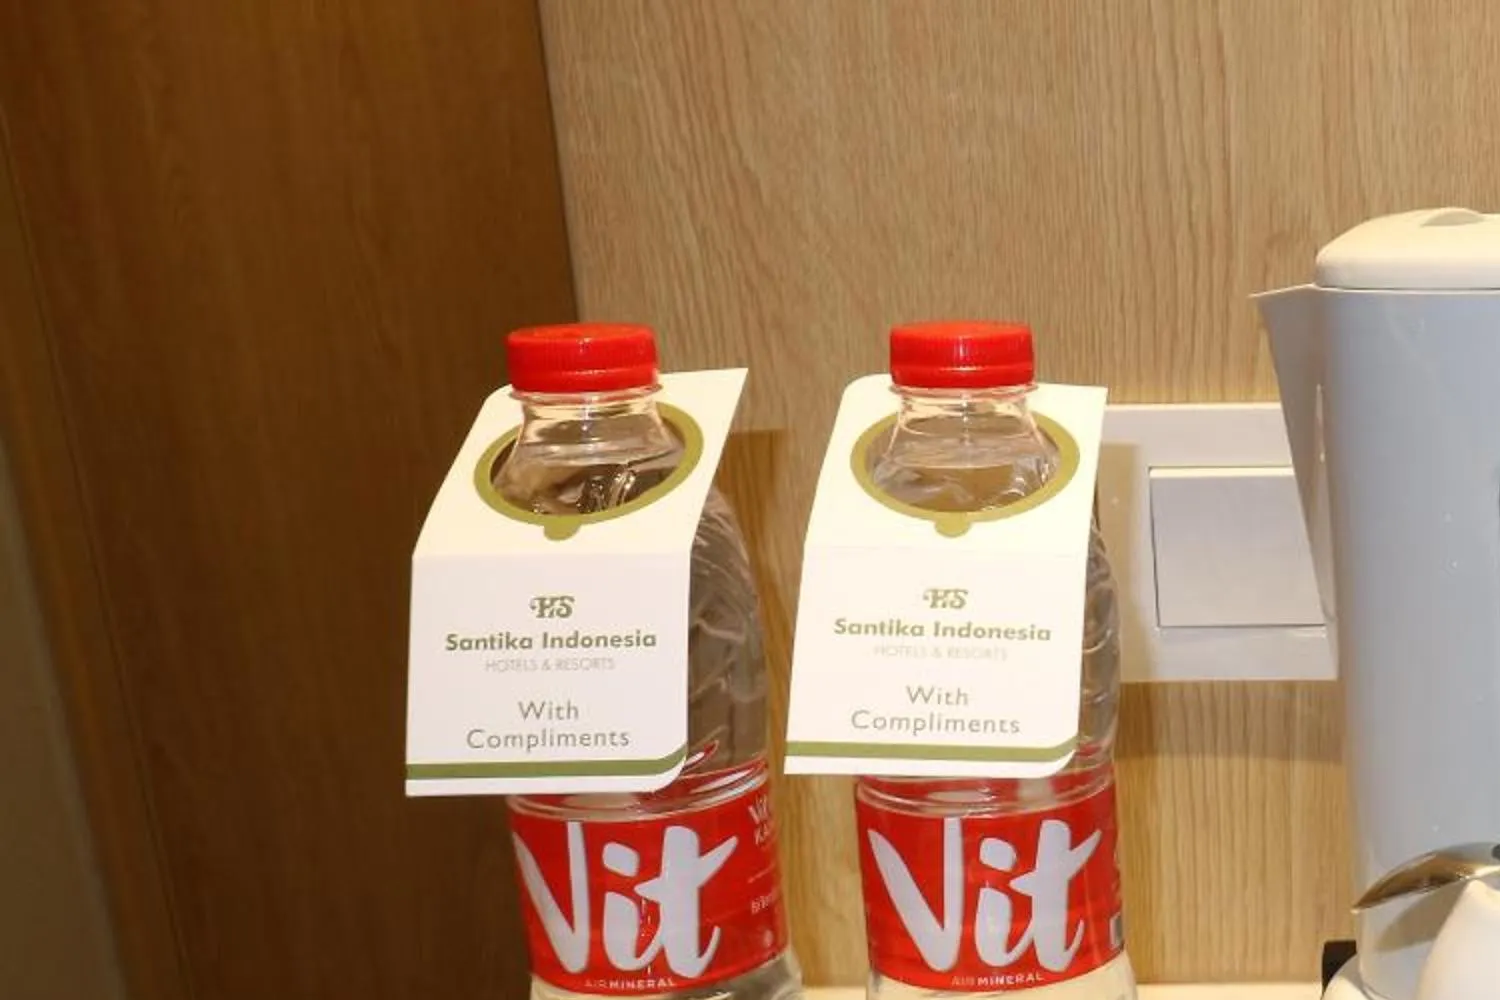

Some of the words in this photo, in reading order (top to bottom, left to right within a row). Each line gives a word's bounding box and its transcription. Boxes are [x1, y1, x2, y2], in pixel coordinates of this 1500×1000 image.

[833, 617, 925, 638] Santika
[933, 621, 1052, 642] Indonesia
[445, 633, 534, 652] Santika
[541, 630, 657, 650] Indonesia
[906, 686, 969, 706] With
[518, 701, 580, 721] With
[850, 710, 1021, 736] Compliments
[465, 728, 631, 751] Compliments
[511, 819, 739, 979] Vit
[867, 816, 1102, 973] Vit
[608, 976, 677, 989] MINERAL
[977, 970, 1045, 986] MINERAL
